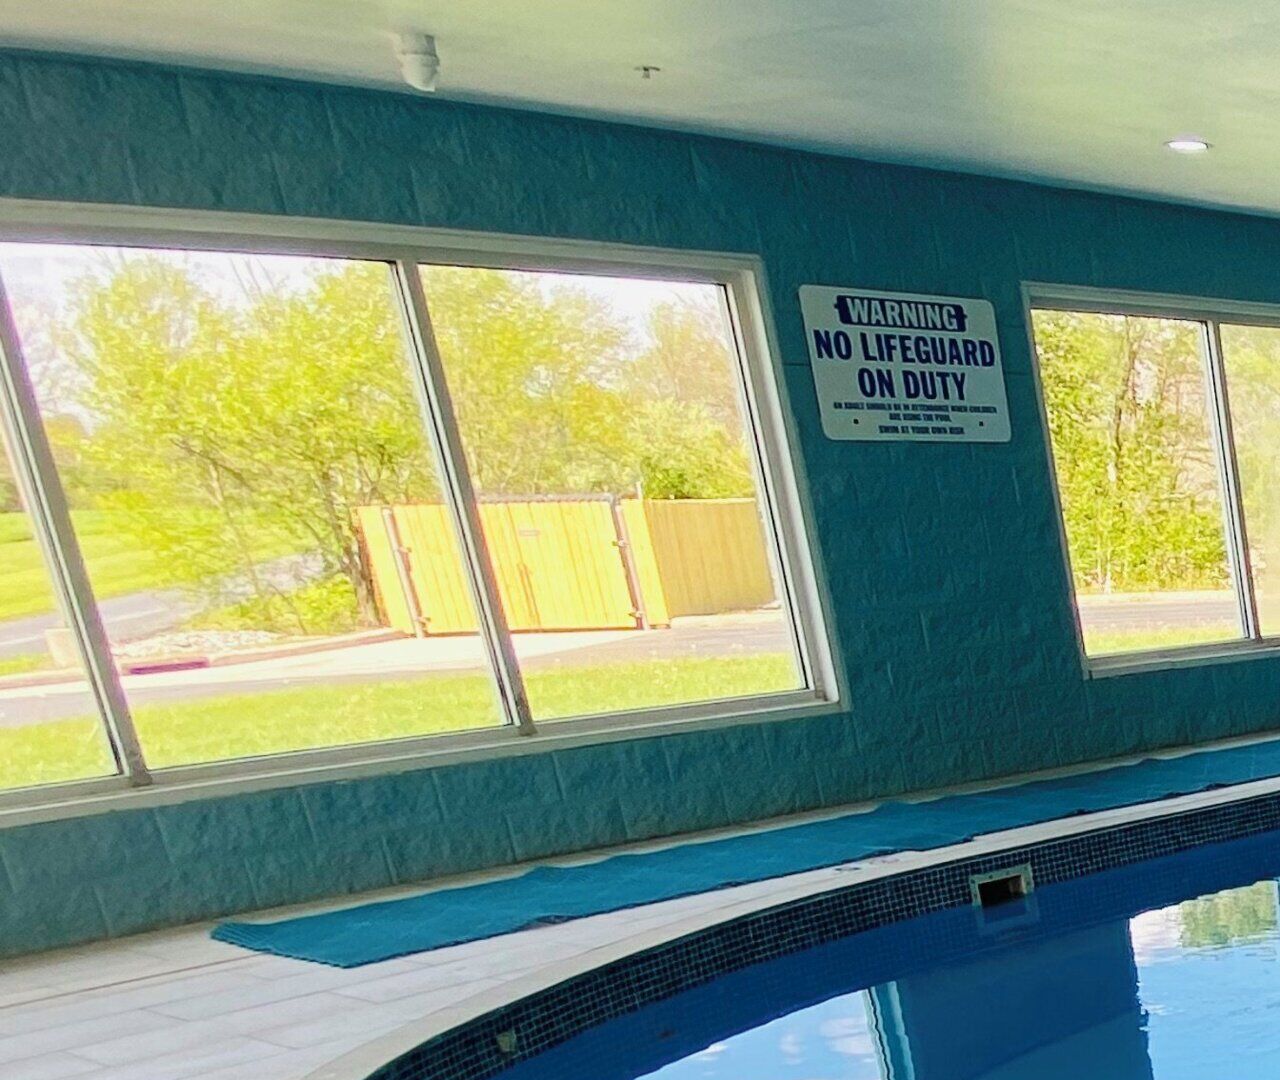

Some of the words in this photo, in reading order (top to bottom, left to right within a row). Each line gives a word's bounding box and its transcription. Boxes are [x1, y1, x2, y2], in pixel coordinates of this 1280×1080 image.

[846, 297, 959, 330] WARNING
[813, 329, 853, 361] NO
[859, 332, 996, 367] LIFEGUARD
[857, 367, 896, 399] ON
[902, 369, 966, 401] DUTY
